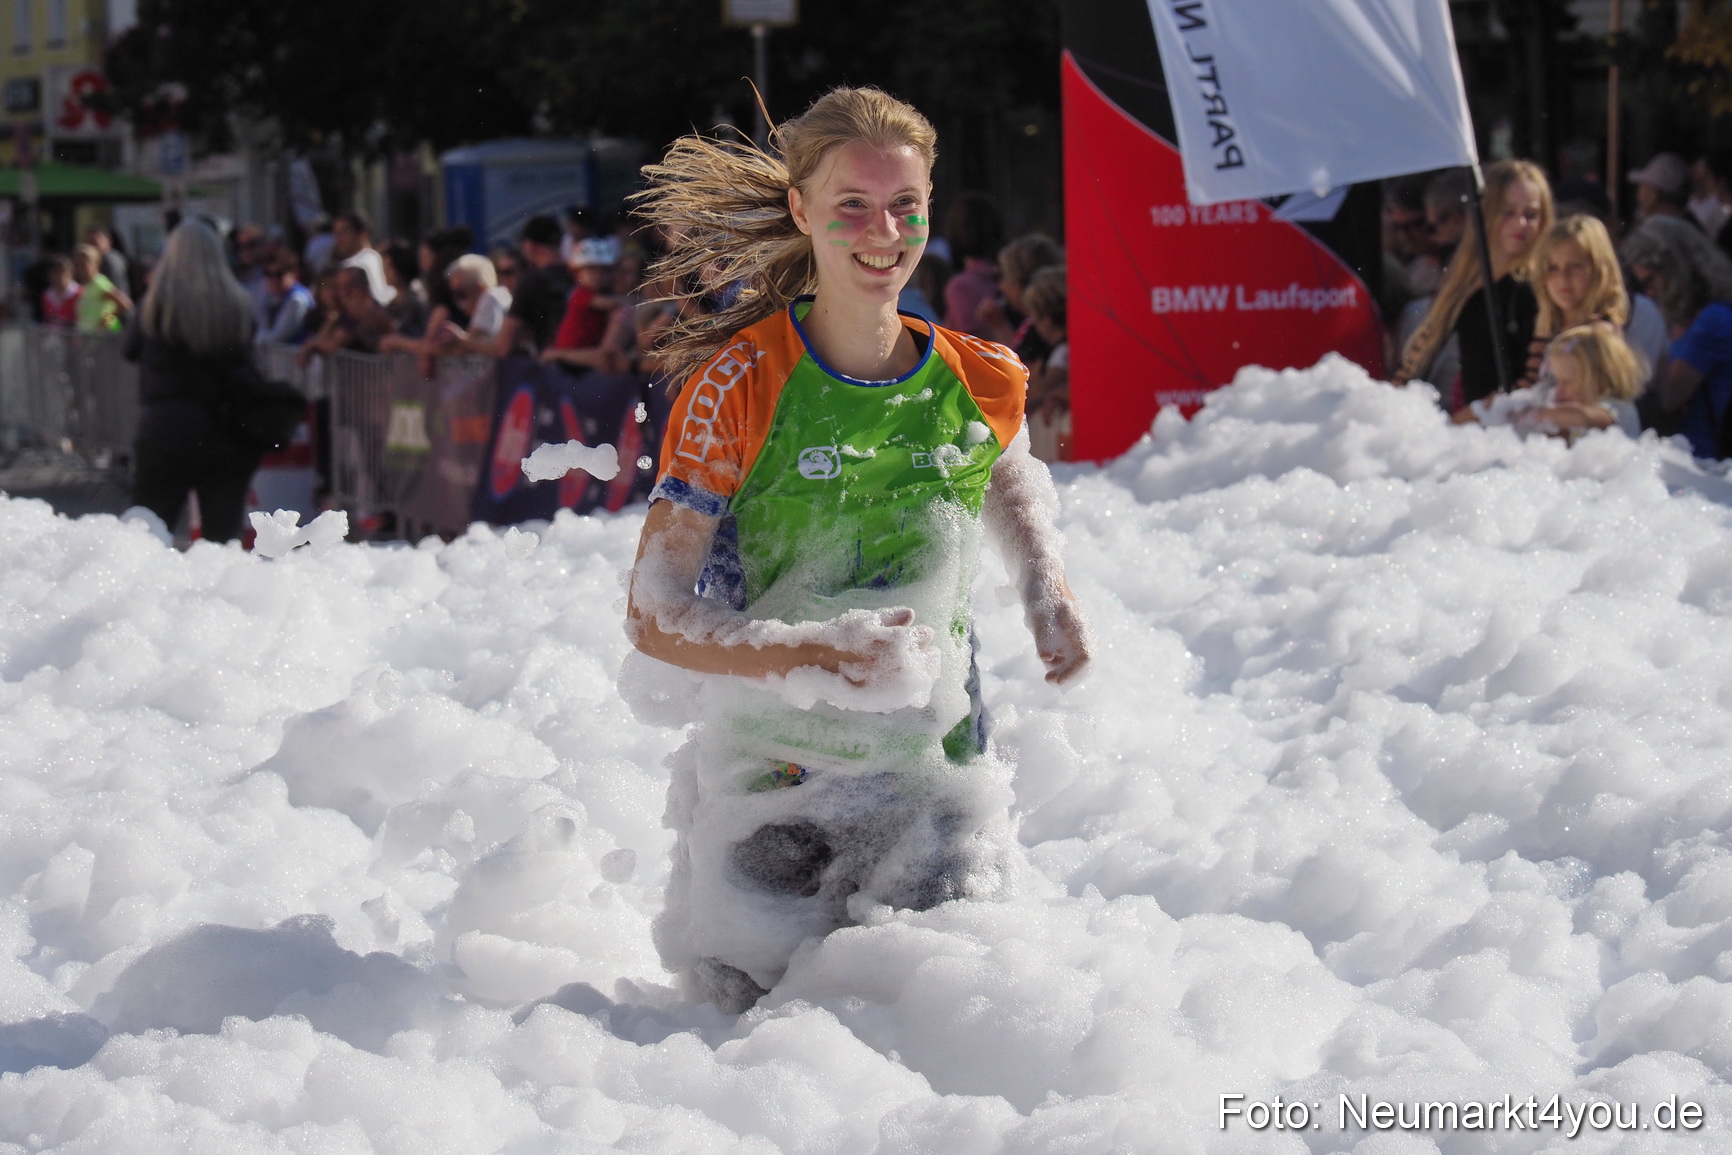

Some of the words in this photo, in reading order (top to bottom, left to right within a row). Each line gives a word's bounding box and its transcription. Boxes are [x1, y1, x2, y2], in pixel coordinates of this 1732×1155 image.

[1151, 205, 1186, 226] 100
[1190, 203, 1260, 225] YEARS
[1151, 286, 1229, 314] BMW
[1235, 283, 1358, 314] Laufsport
